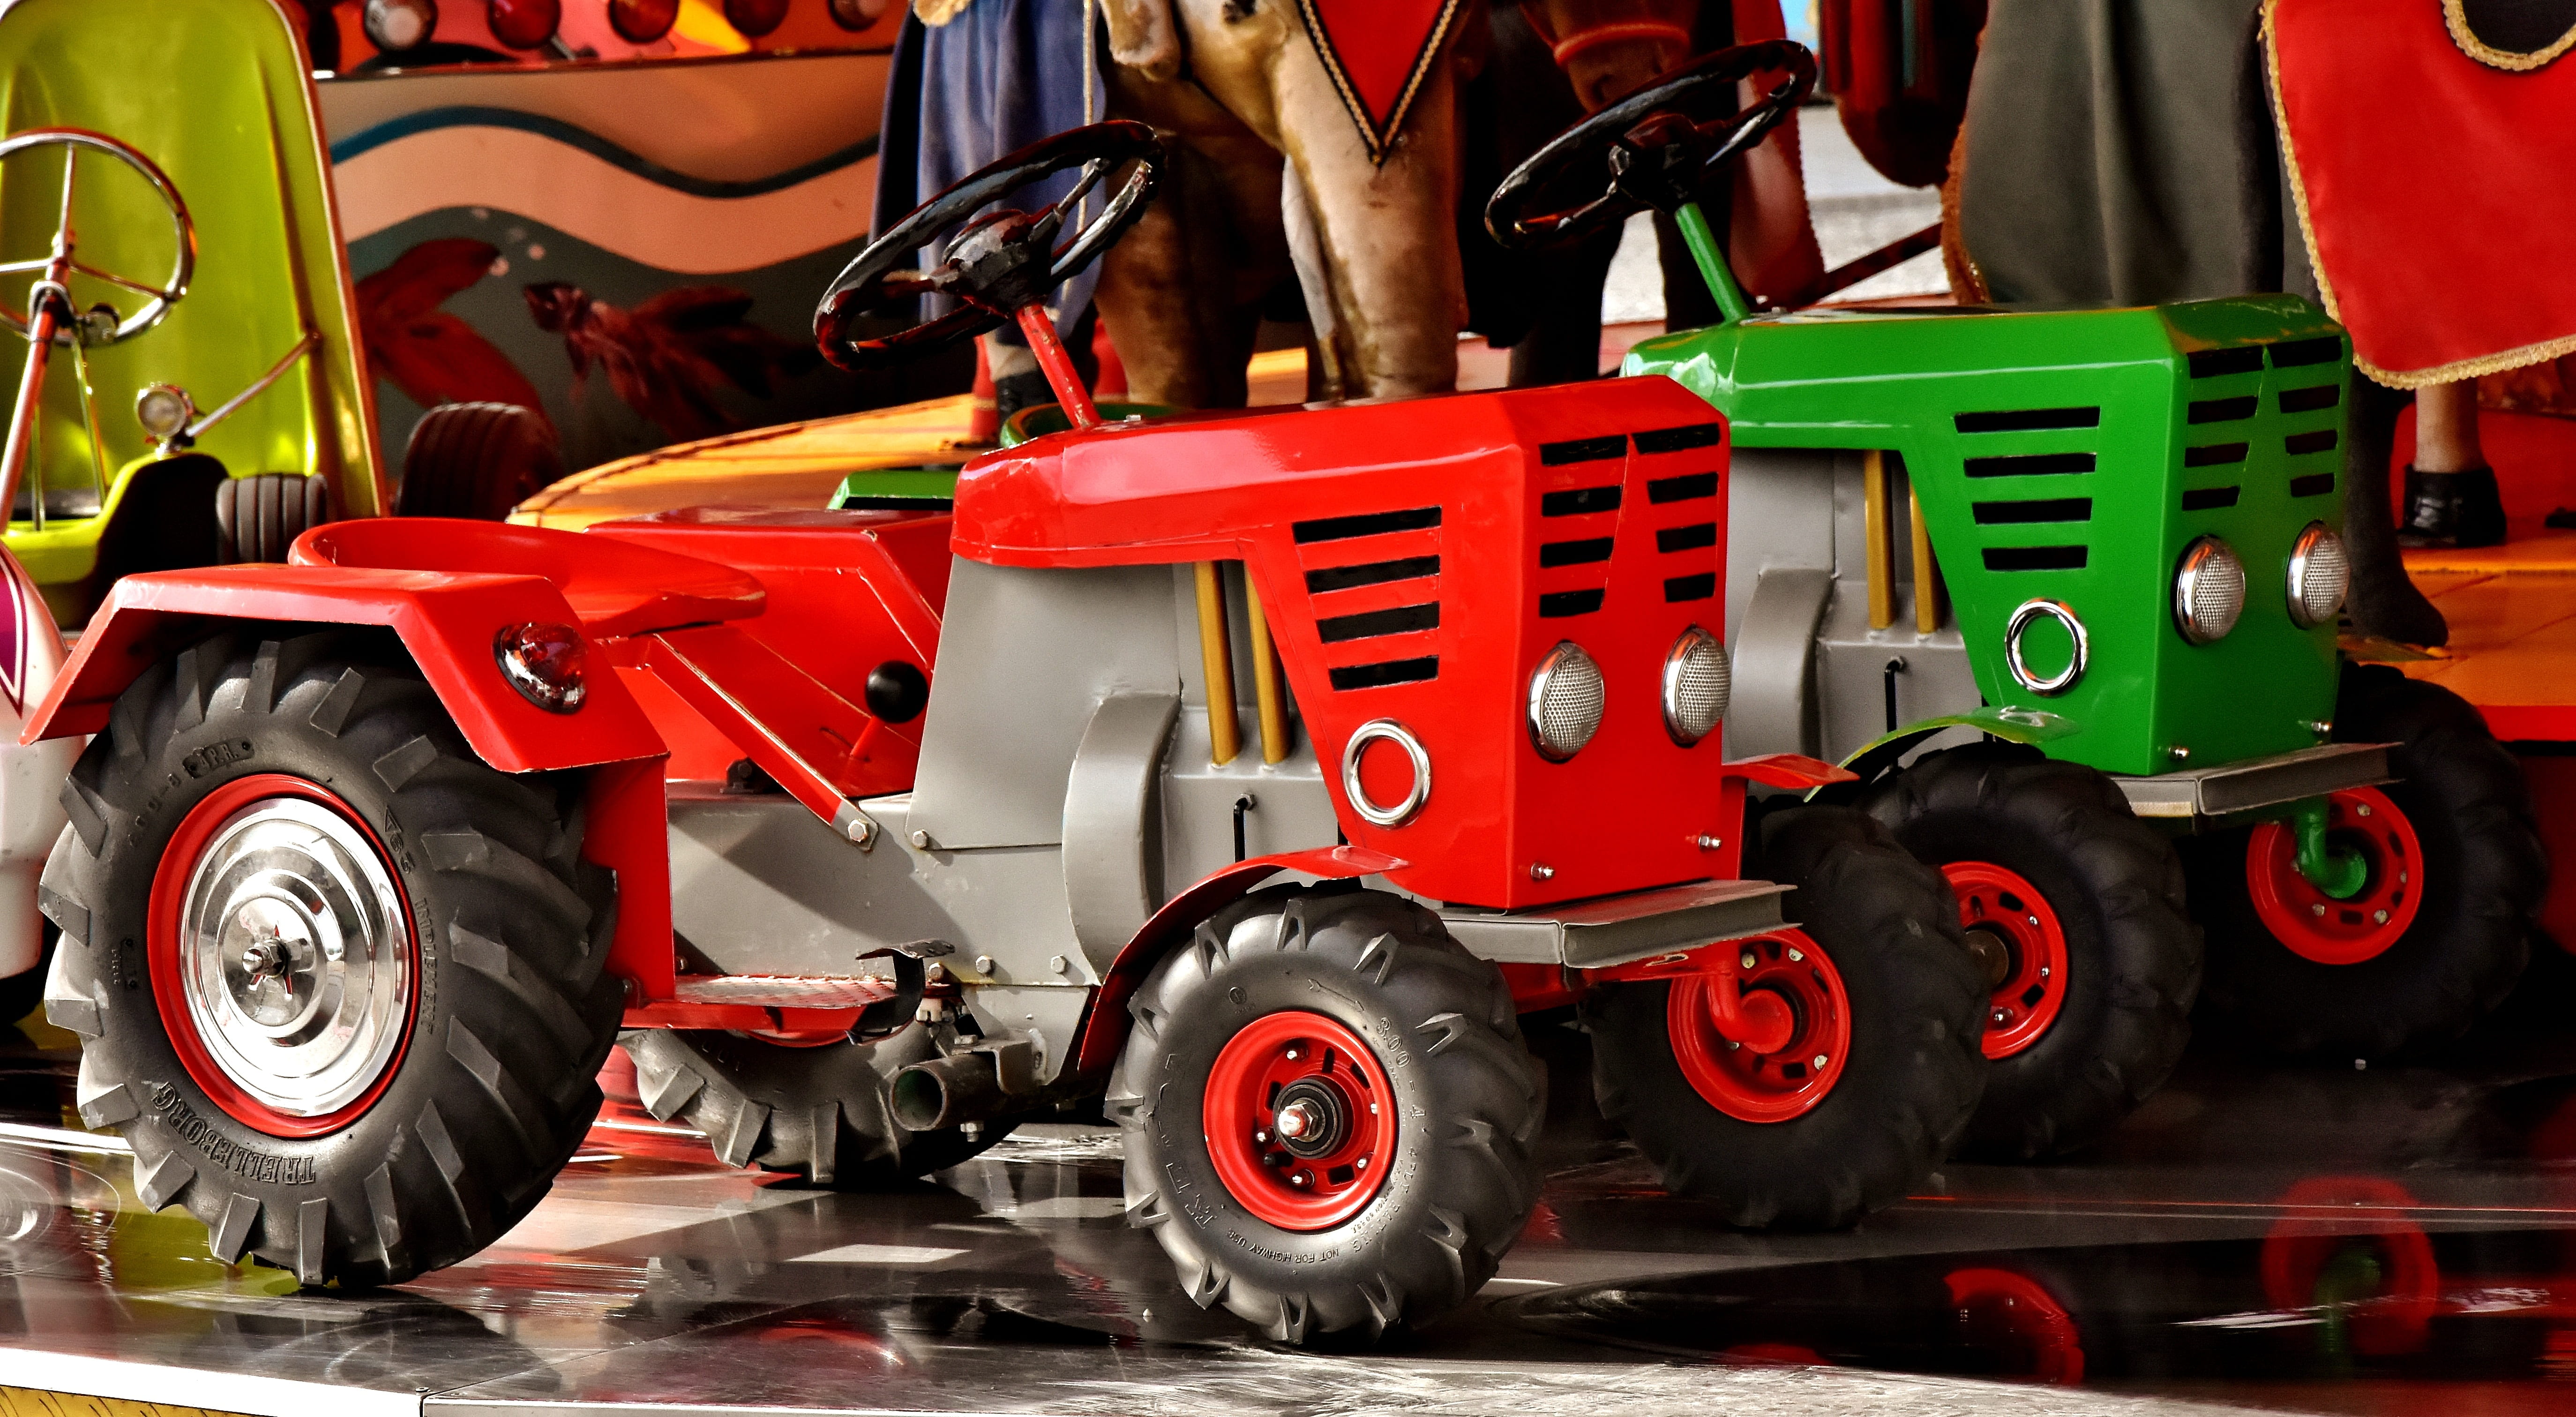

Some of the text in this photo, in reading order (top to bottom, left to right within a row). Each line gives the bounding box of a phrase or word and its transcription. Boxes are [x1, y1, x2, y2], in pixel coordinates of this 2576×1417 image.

[151, 1081, 316, 1185] TRELLEBORG
[1249, 1243, 1292, 1262] HIGHWAY
[1295, 1253, 1315, 1263] FOR
[1319, 1247, 1339, 1261] NOT
